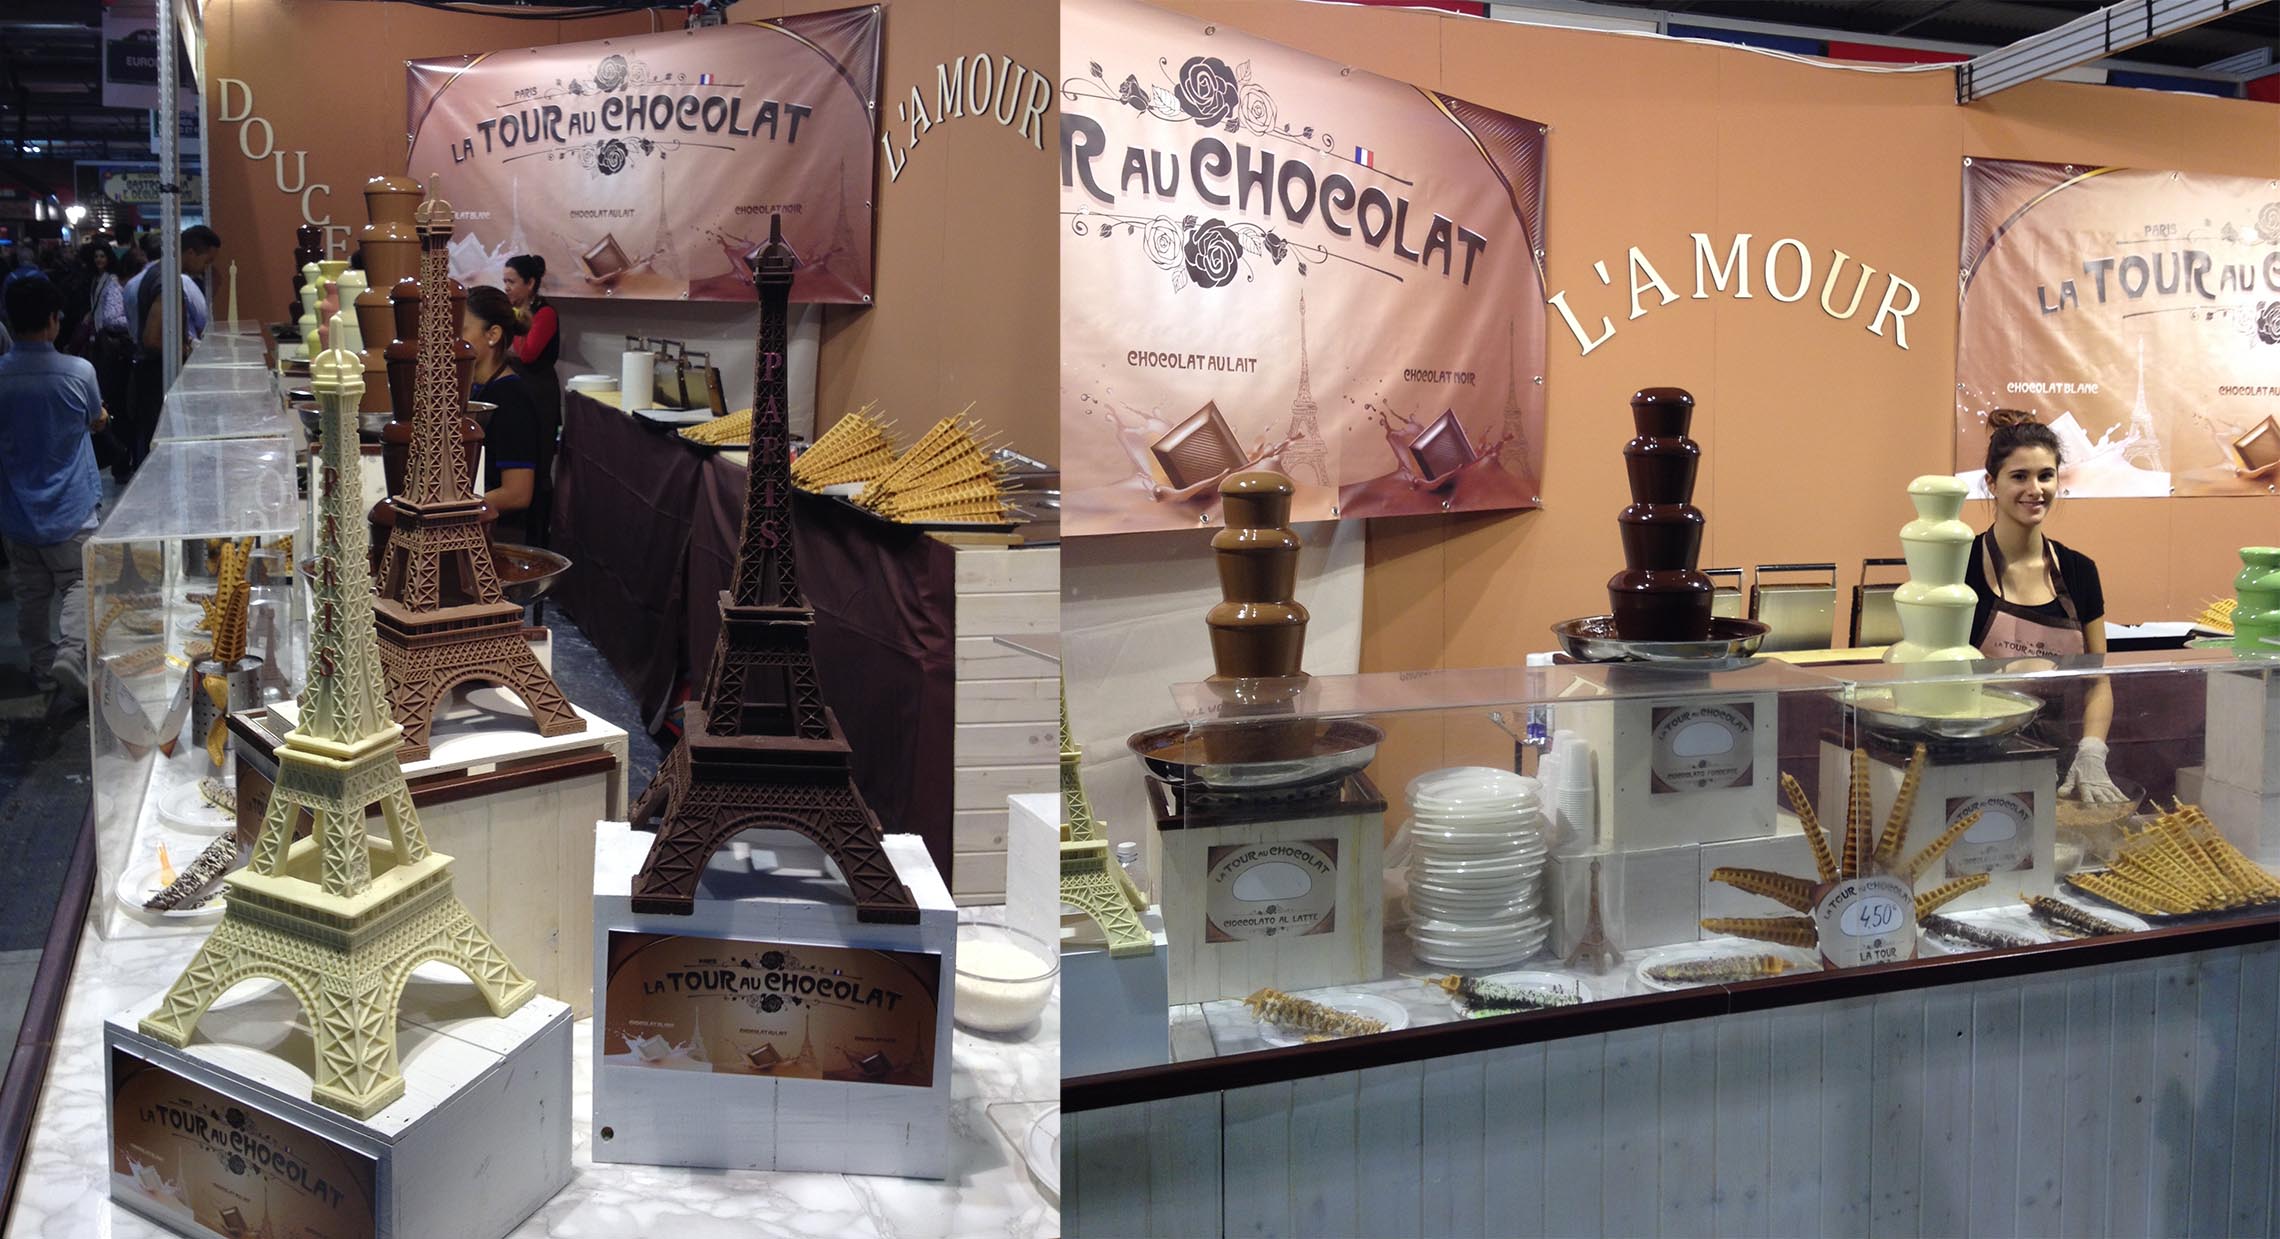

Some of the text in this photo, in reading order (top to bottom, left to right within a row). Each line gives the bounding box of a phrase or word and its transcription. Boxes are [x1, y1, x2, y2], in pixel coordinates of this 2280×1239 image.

[514, 86, 538, 101] PARIS
[450, 94, 813, 165] LA TOUR AU CHOCOLAT
[881, 52, 1054, 184] L'AMOUR
[1121, 146, 1180, 199] AU
[1190, 137, 1488, 287] CHOCOLAT
[2144, 223, 2177, 237] PARIS
[1547, 232, 1922, 357] L'AMOUR
[2037, 279, 2079, 315] LA
[2083, 250, 2216, 304] TOUR
[2220, 264, 2256, 293] AU
[1127, 349, 1205, 370] CHOCOLAT
[1403, 368, 1476, 387] CHOCOLAT NOIR
[2007, 381, 2099, 394] CHOCOLAT BLANC
[2218, 385, 2268, 396] CHOCOLAT
[759, 352, 783, 549] PARIS
[319, 466, 339, 677] PARIS
[2003, 640, 2028, 655] TOUR
[1664, 711, 1691, 731] TOUR
[1700, 707, 1748, 734] CHOCOLAT
[1957, 801, 1980, 820] TOUR
[1987, 798, 2029, 821] CHOCOLAT
[1215, 872, 1226, 884] LA
[1223, 850, 1258, 872] TOUR
[1269, 846, 1330, 874] CHOCOLAT
[1829, 886, 1858, 909] TOUR
[1223, 912, 1319, 928] CIOCCOLATO AL LATTE
[1860, 946, 1897, 962] LA TOUR
[643, 969, 904, 1012] LA TOUR AU CHOCOLAT
[139, 1110, 156, 1124] LA
[155, 1104, 211, 1143] TOUR
[211, 1128, 228, 1147] AU
[230, 1130, 345, 1209] CHOCOLAT
